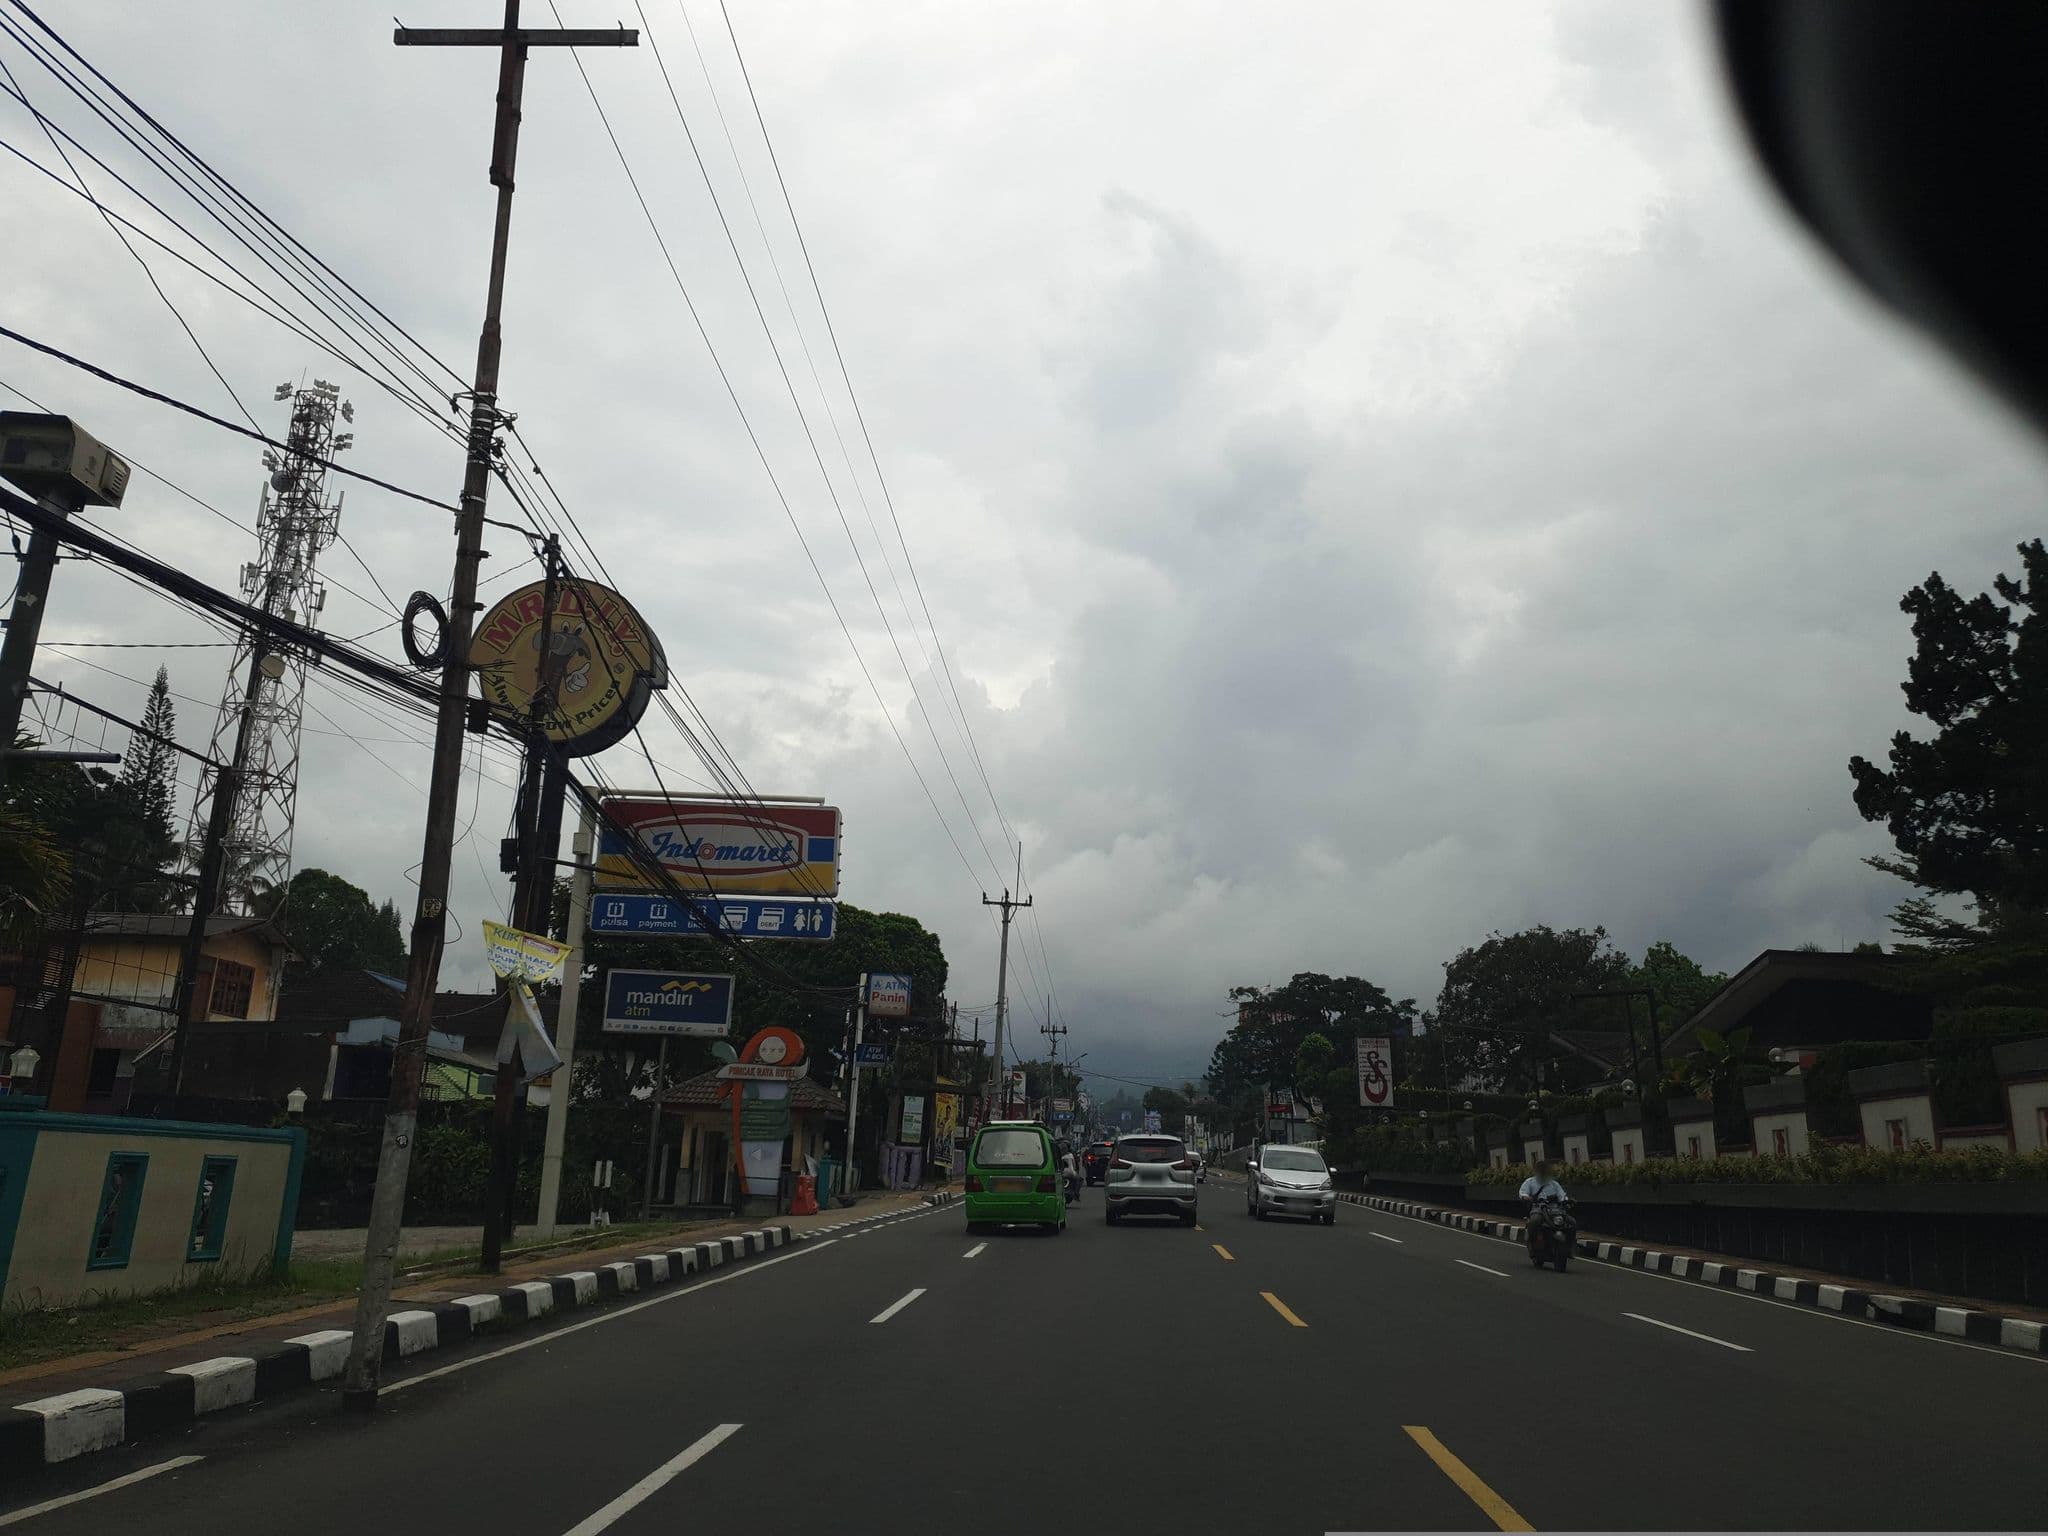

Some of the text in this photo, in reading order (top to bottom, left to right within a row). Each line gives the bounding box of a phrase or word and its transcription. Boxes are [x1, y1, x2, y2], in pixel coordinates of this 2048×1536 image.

[575, 680, 620, 725] Price
[651, 830, 793, 864] Indomaret
[600, 917, 628, 927] pulsa
[638, 920, 678, 929] payment
[626, 989, 693, 1006] mandiri
[872, 991, 906, 1003] Panin
[624, 1006, 651, 1017] atm
